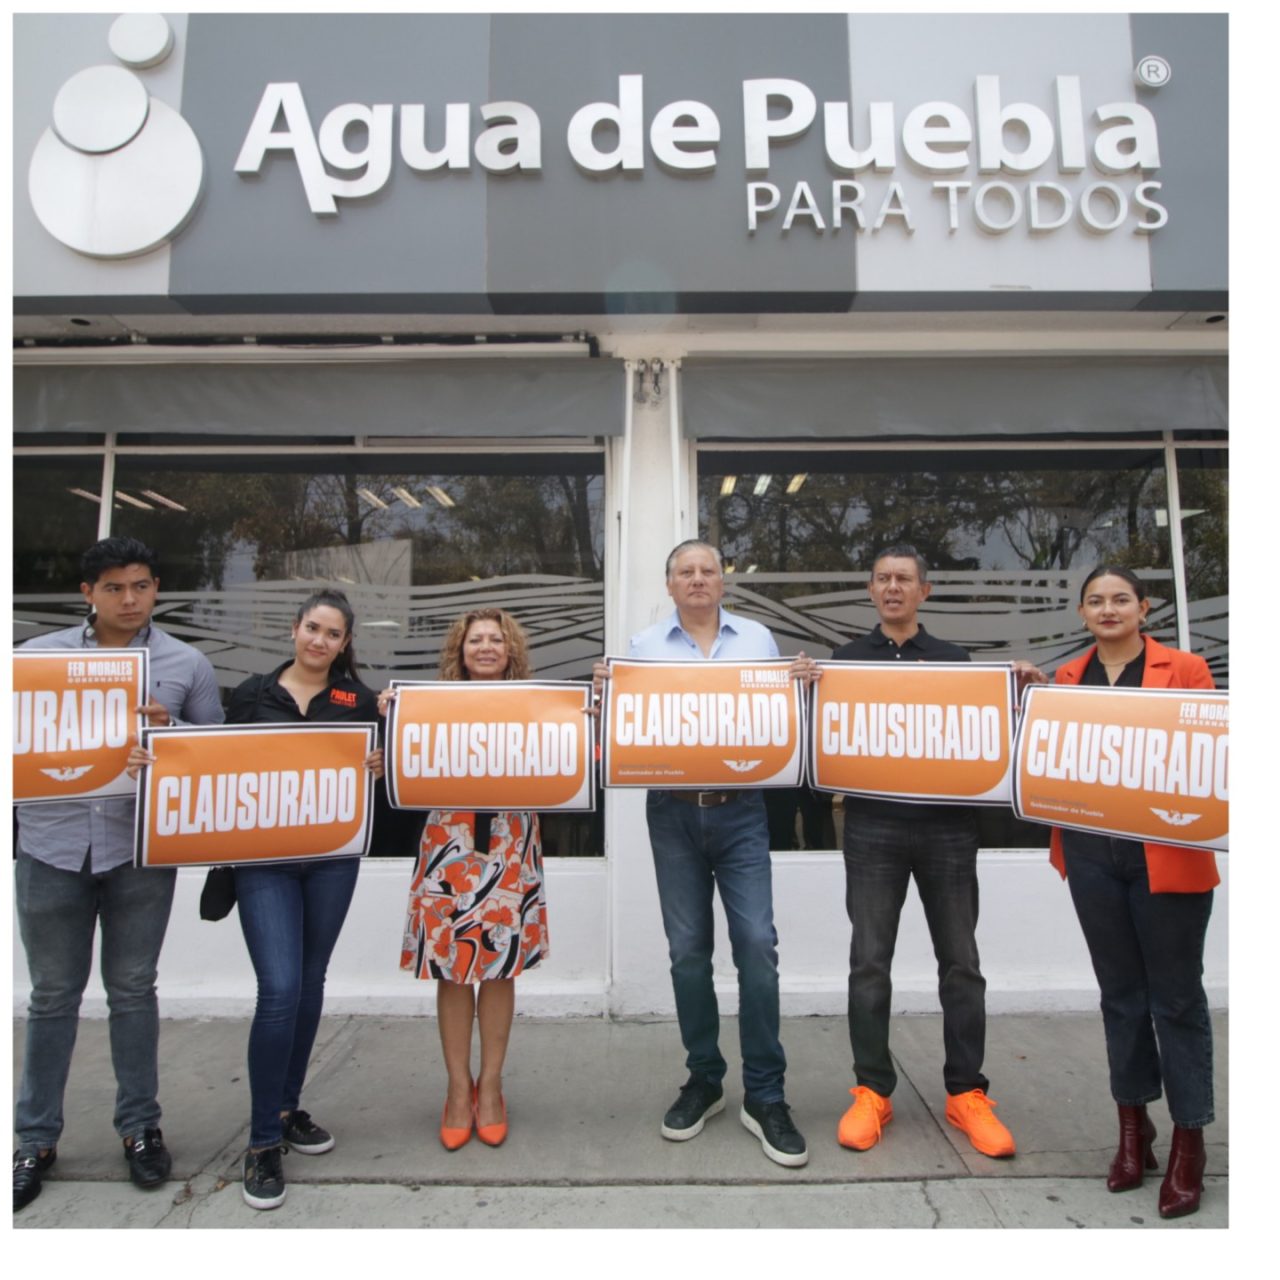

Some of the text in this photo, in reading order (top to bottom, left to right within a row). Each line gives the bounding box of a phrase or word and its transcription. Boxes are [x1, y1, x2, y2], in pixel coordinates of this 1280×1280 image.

[235, 80, 543, 215] Agua
[566, 74, 720, 172] de
[742, 74, 1161, 172] Puebla
[745, 180, 1170, 236] PARA TODOS
[67, 661, 133, 677] FER MORALES
[740, 670, 790, 683] FER MORALES
[616, 693, 789, 747] CLAUSURADO
[822, 702, 1000, 761] CLAUSURADO
[1180, 703, 1197, 718] FER
[402, 723, 577, 778] CLAUSURADO
[156, 767, 356, 836] CLAUSURADO
